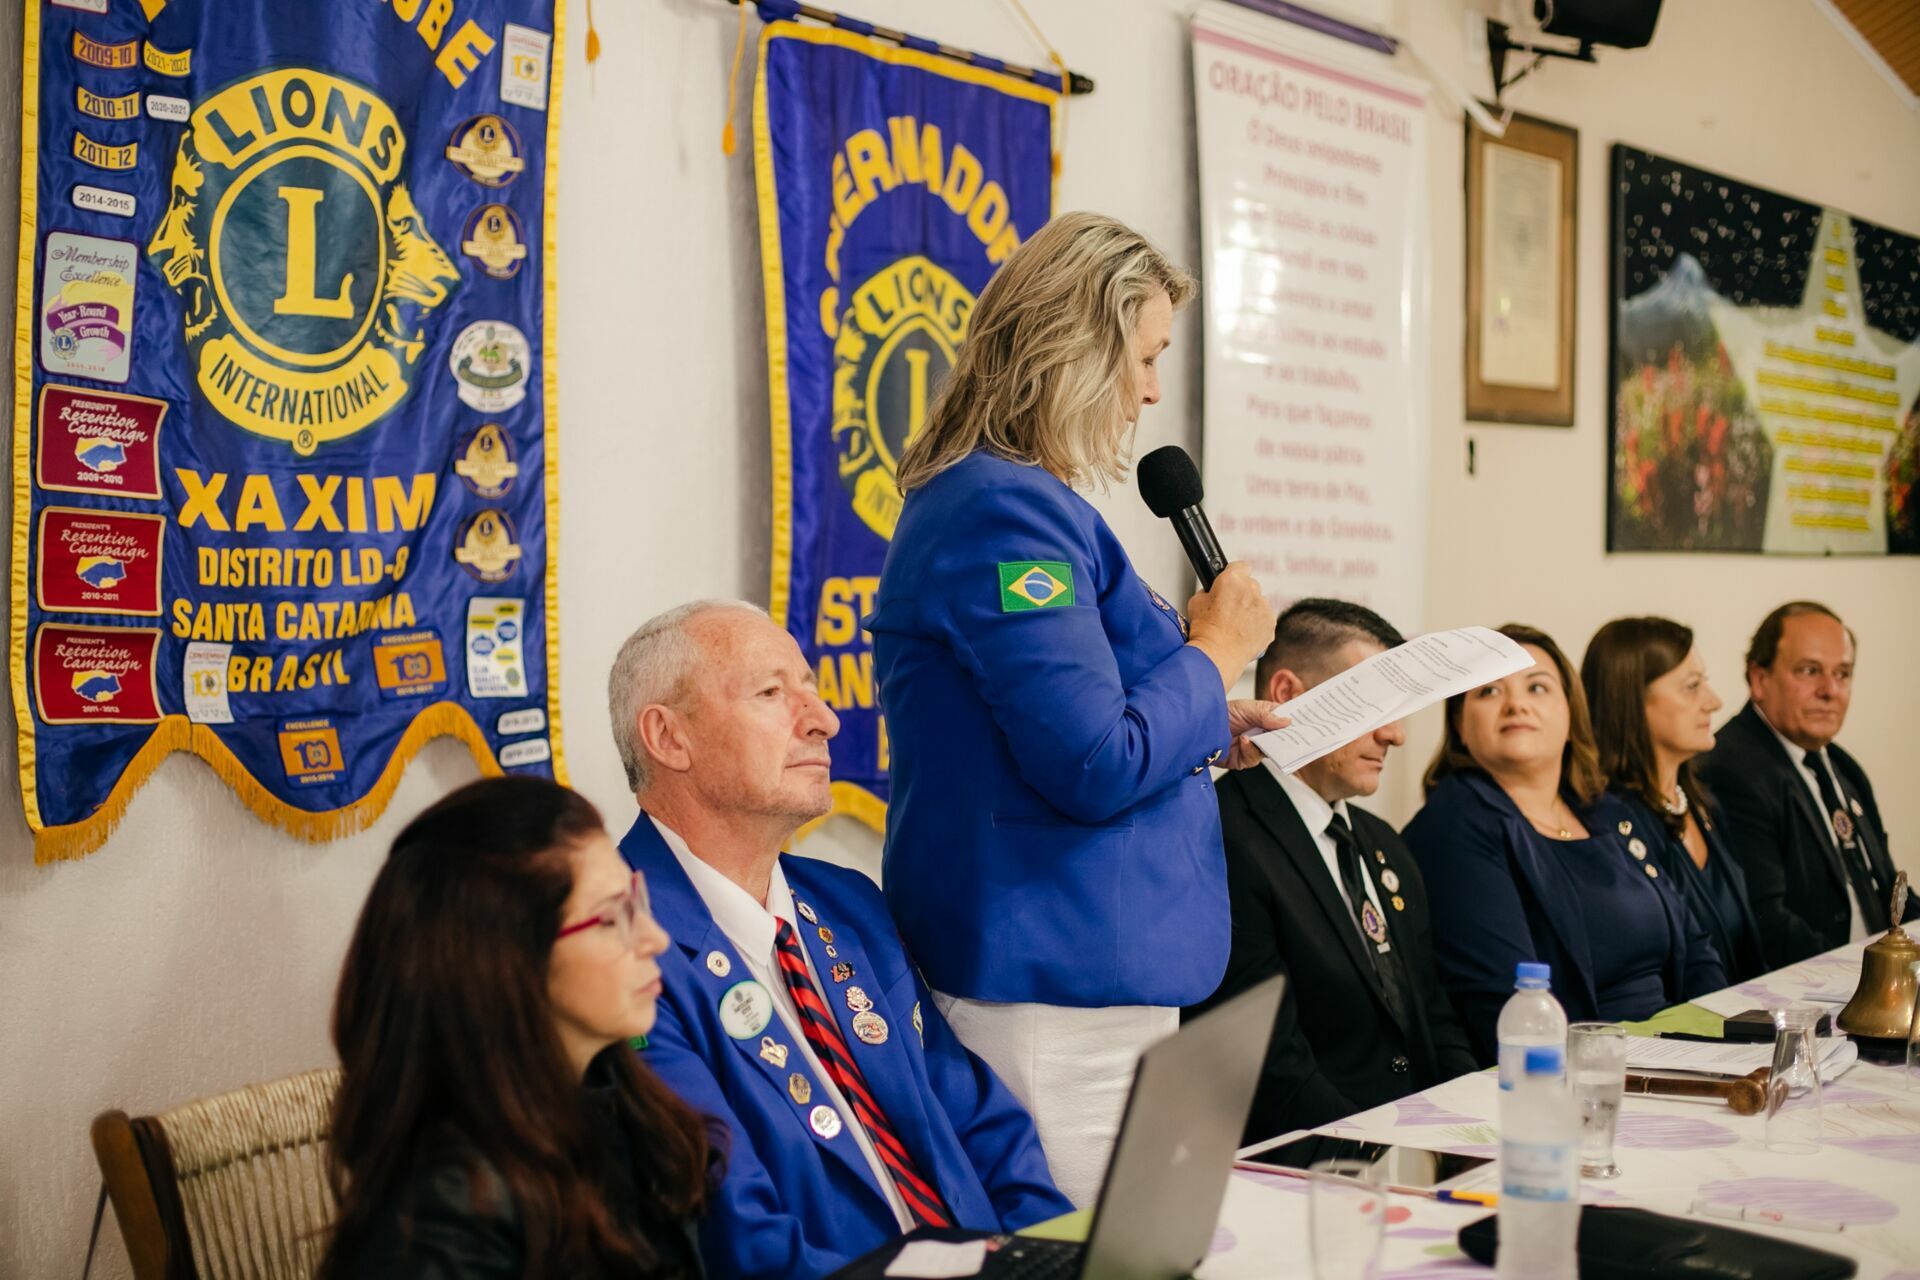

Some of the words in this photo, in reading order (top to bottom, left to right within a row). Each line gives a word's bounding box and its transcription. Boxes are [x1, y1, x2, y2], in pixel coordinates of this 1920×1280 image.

[79, 38, 131, 66] 2009-10
[147, 48, 188, 73] 2021-2022
[84, 93, 133, 117] 2010-11
[151, 101, 187, 115] 2020-2021
[1209, 61, 1300, 112] ORAÇÃO
[1303, 88, 1349, 126] PELO
[1354, 103, 1412, 146] BRASIL
[205, 78, 397, 170] LIONS
[80, 139, 131, 166] 2011-12
[80, 192, 130, 211] 2014-2015
[51, 245, 130, 272] Membership
[60, 265, 121, 288] Excellence
[58, 305, 107, 324] Year-Round
[80, 326, 110, 338] Growth
[209, 352, 389, 425] INTERNATIONAL
[58, 406, 139, 429] Retention
[68, 421, 148, 447] Campaign
[175, 467, 436, 533] XAXIM
[60, 529, 138, 547] Retention
[69, 541, 149, 563] Campaign
[198, 546, 333, 588] DISTRITO
[340, 545, 410, 586] LD-8
[81, 592, 119, 601] 2010-2011
[172, 597, 266, 642] SANTA
[55, 644, 132, 660] Retention
[63, 656, 142, 677] Campaign
[227, 648, 350, 693] BRASIL
